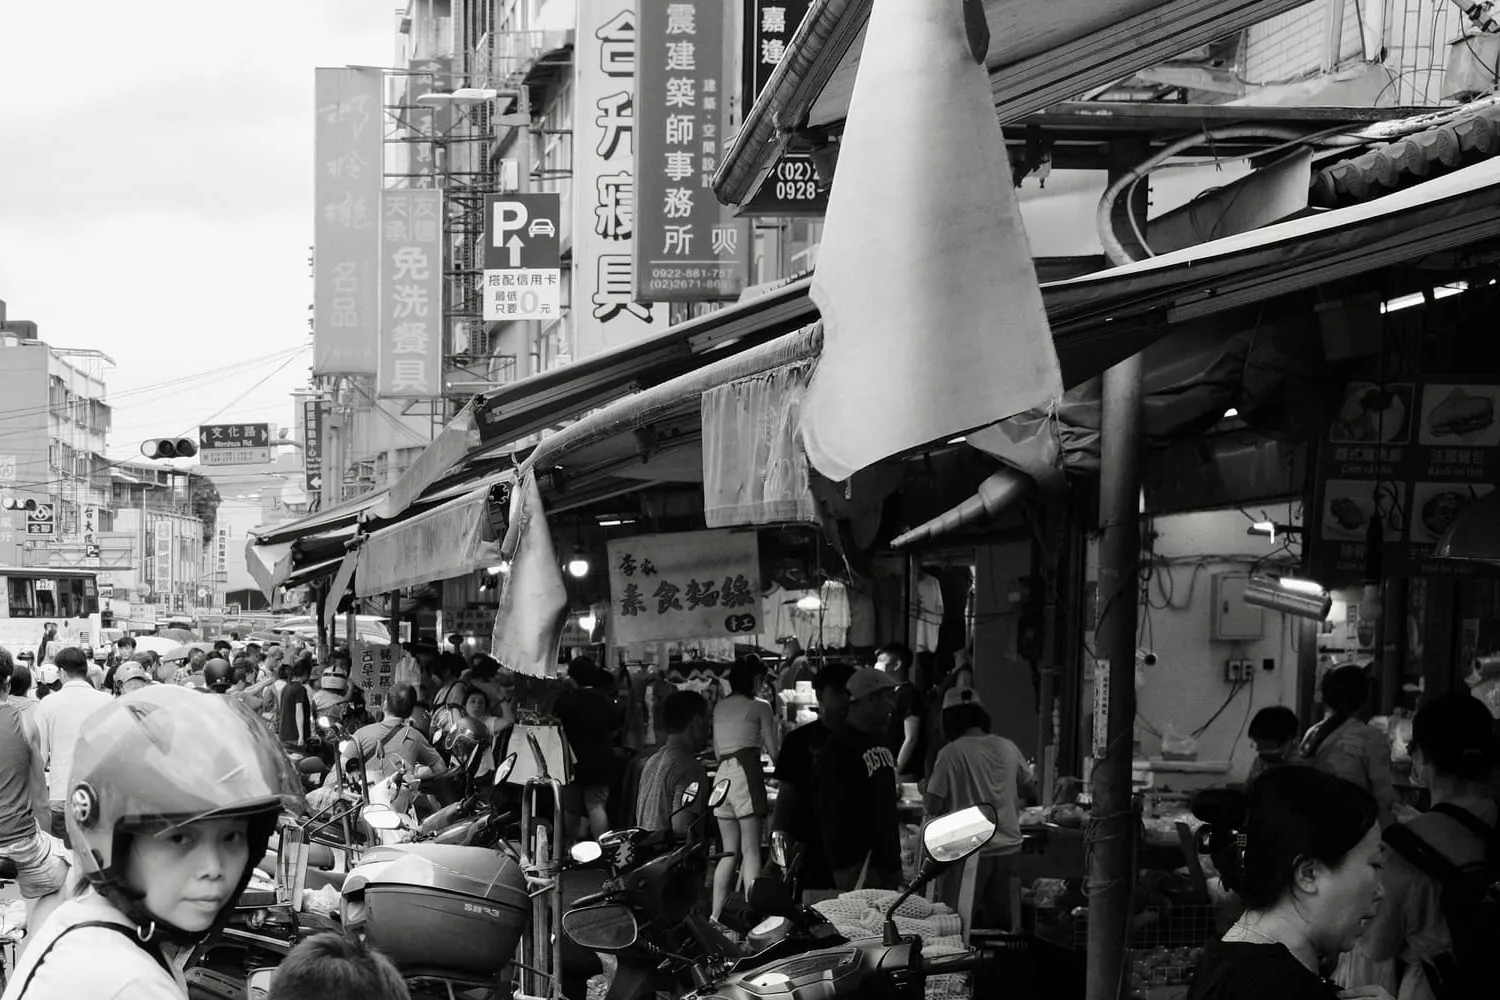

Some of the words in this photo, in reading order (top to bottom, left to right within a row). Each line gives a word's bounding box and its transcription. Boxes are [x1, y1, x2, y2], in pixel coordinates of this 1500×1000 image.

[663, 3, 697, 255] 震建築師事務所
[493, 201, 528, 247] P
[489, 274, 557, 287] 搭配信用卡
[392, 246, 430, 392] 免洗餐具
[520, 290, 539, 314] 0
[540, 304, 551, 314] 元
[211, 425, 256, 438] 文化路
